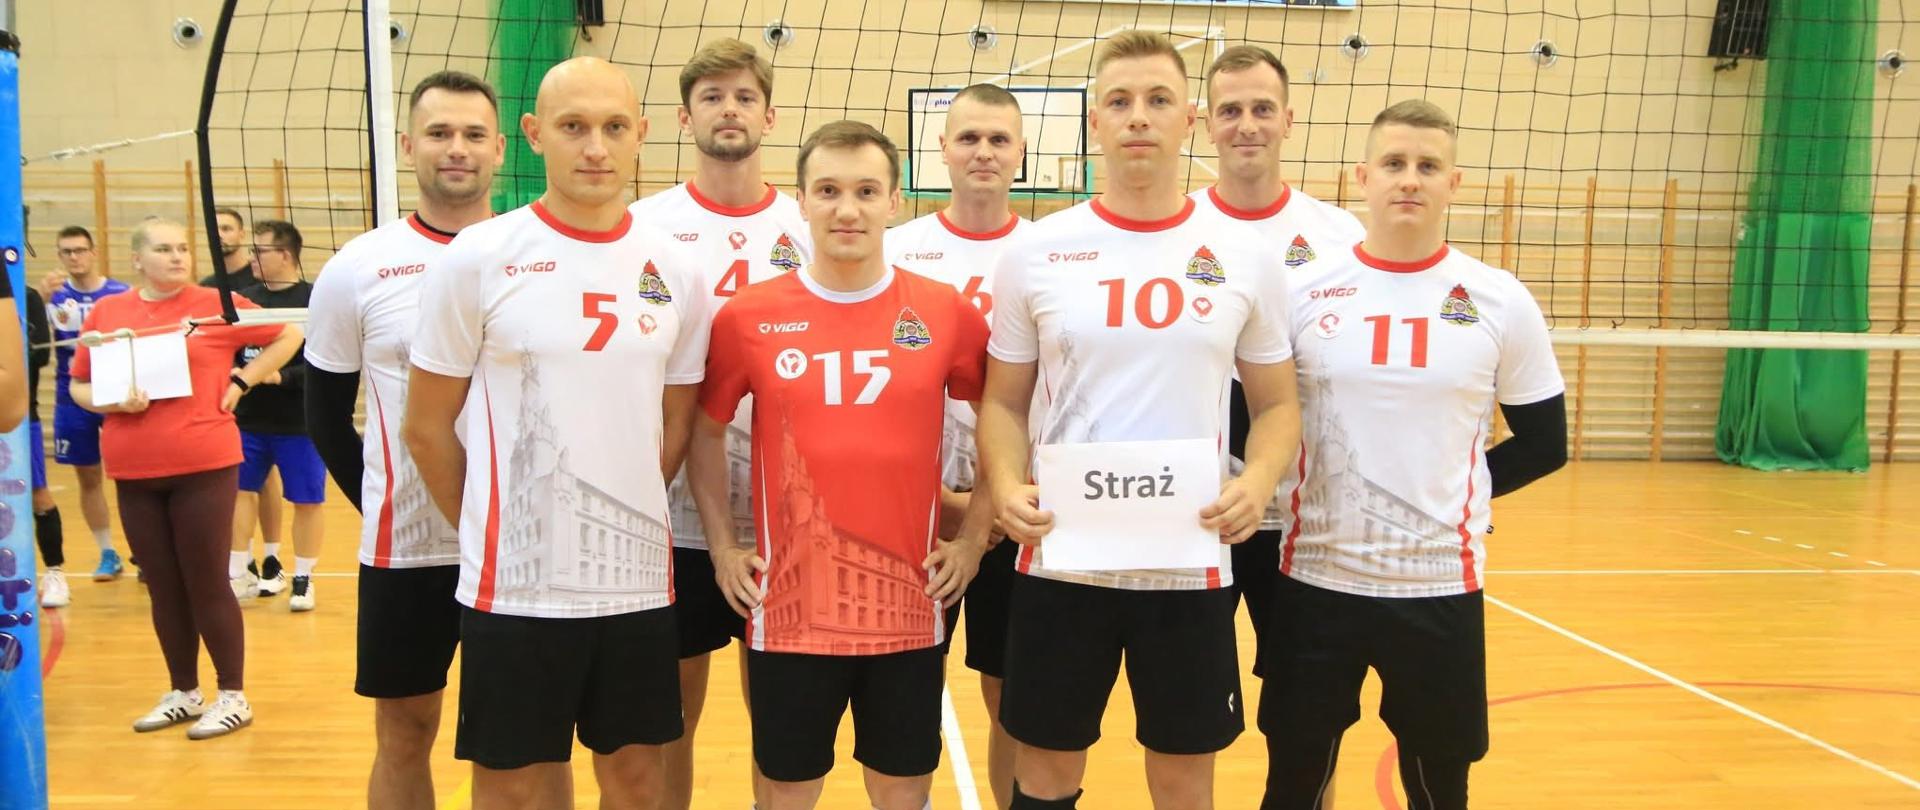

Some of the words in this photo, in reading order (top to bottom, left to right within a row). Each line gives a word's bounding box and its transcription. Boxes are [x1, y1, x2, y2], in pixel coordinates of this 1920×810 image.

[714, 259, 749, 297] 4
[962, 276, 993, 317] 6
[1098, 277, 1185, 329] 10
[582, 292, 620, 352] 5
[1363, 314, 1429, 369] 11
[813, 349, 892, 405] 15
[1084, 465, 1175, 500] Straż
